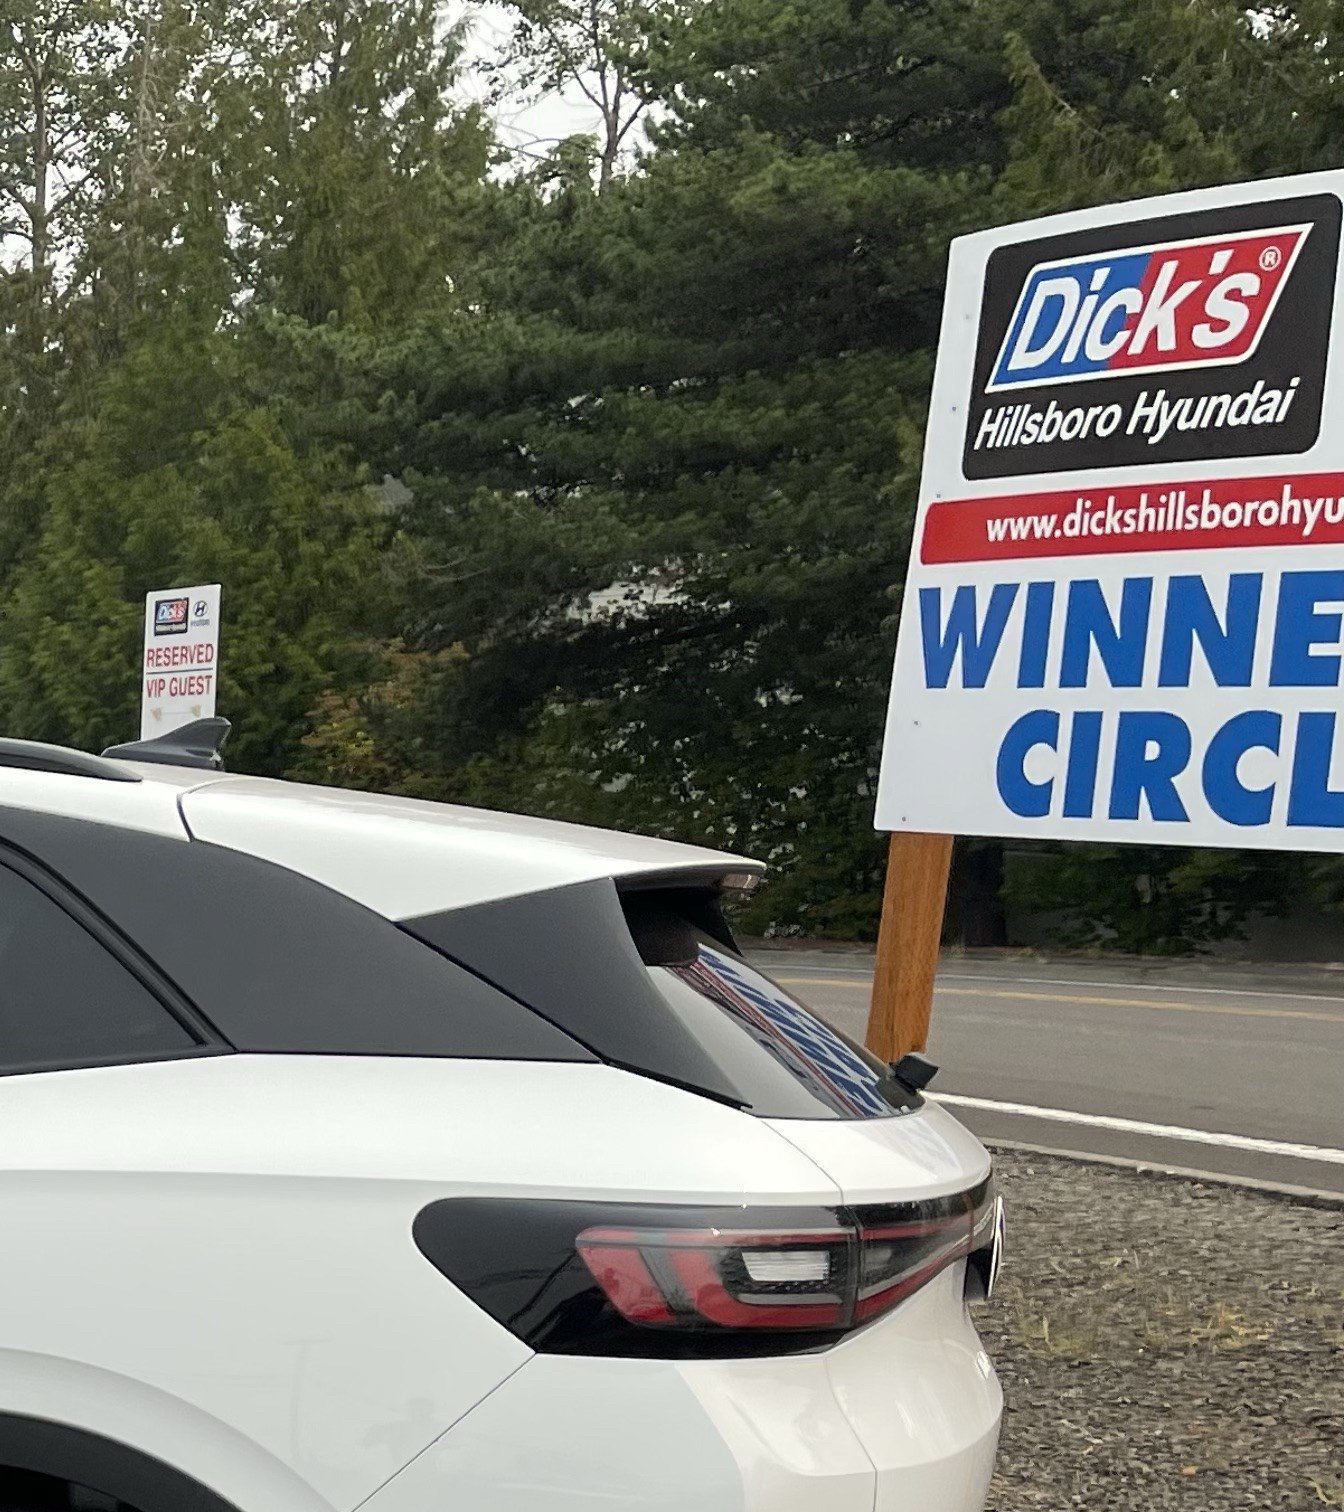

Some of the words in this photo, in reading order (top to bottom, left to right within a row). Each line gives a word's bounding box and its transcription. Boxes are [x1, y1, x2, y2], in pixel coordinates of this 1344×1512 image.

[973, 400, 1121, 450] Hillsboro
[1126, 376, 1301, 445] Hyundai
[146, 643, 214, 668] RESERVED
[146, 678, 165, 698] VIP
[169, 675, 213, 697] GUEST
